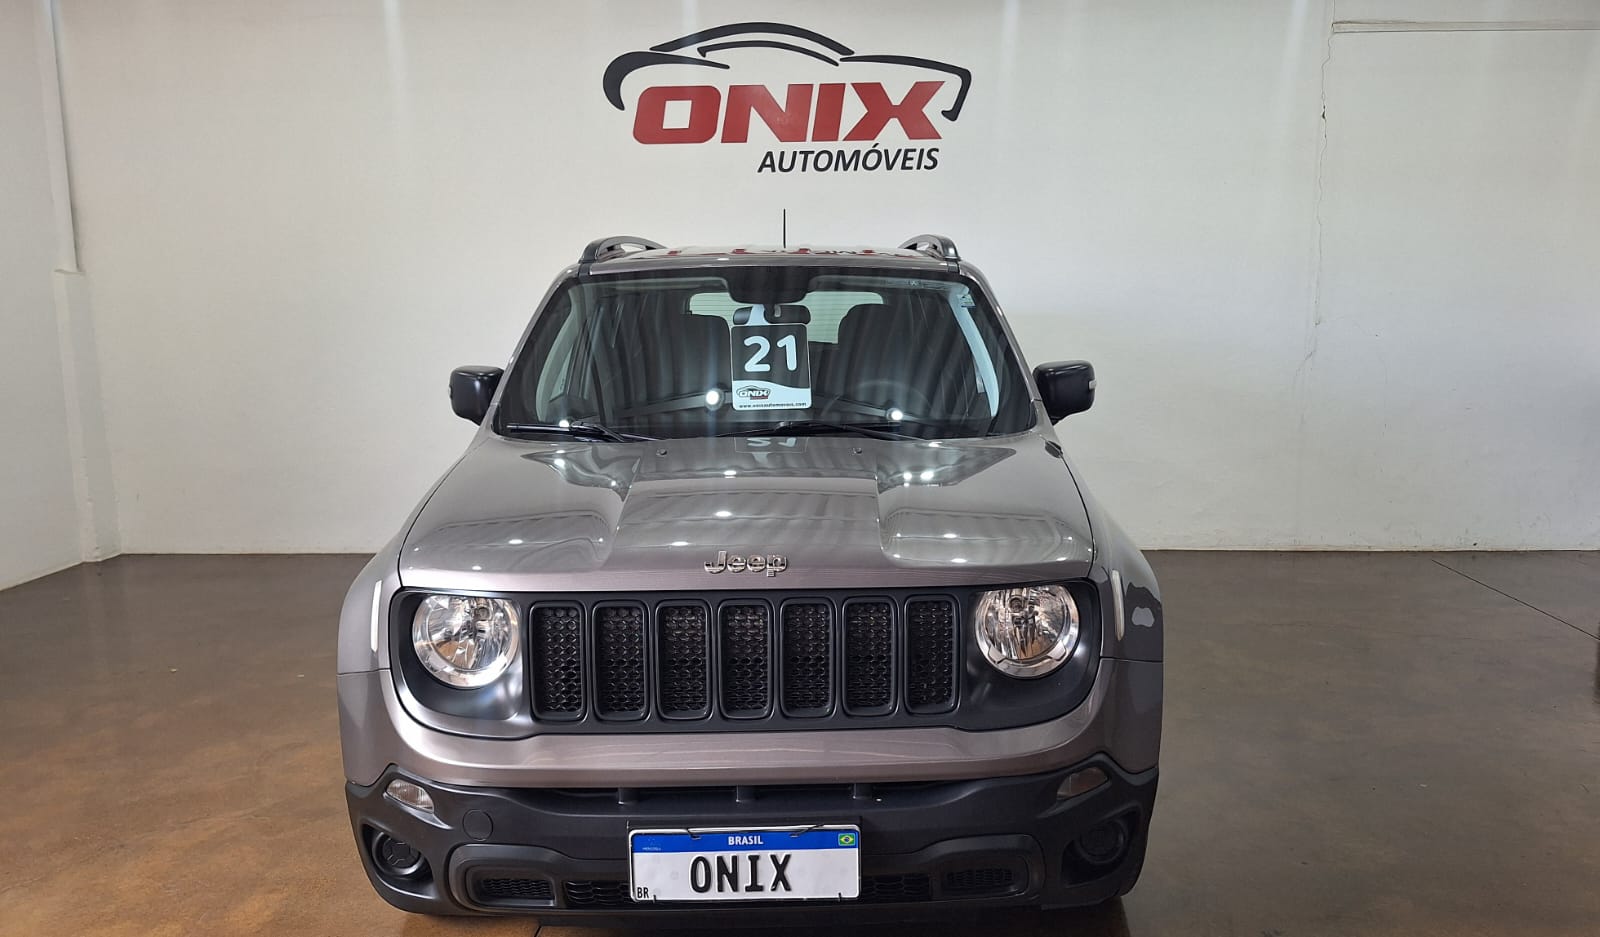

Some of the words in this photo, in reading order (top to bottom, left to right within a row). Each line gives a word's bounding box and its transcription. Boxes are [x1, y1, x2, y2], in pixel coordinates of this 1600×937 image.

[633, 81, 946, 144] ONIX
[757, 143, 940, 173] AUTOMÓVEIS
[744, 334, 797, 372] 21
[704, 551, 787, 577] Jeep
[728, 836, 764, 846] BRASIL
[690, 854, 792, 893] ONIX
[637, 887, 649, 899] BR
